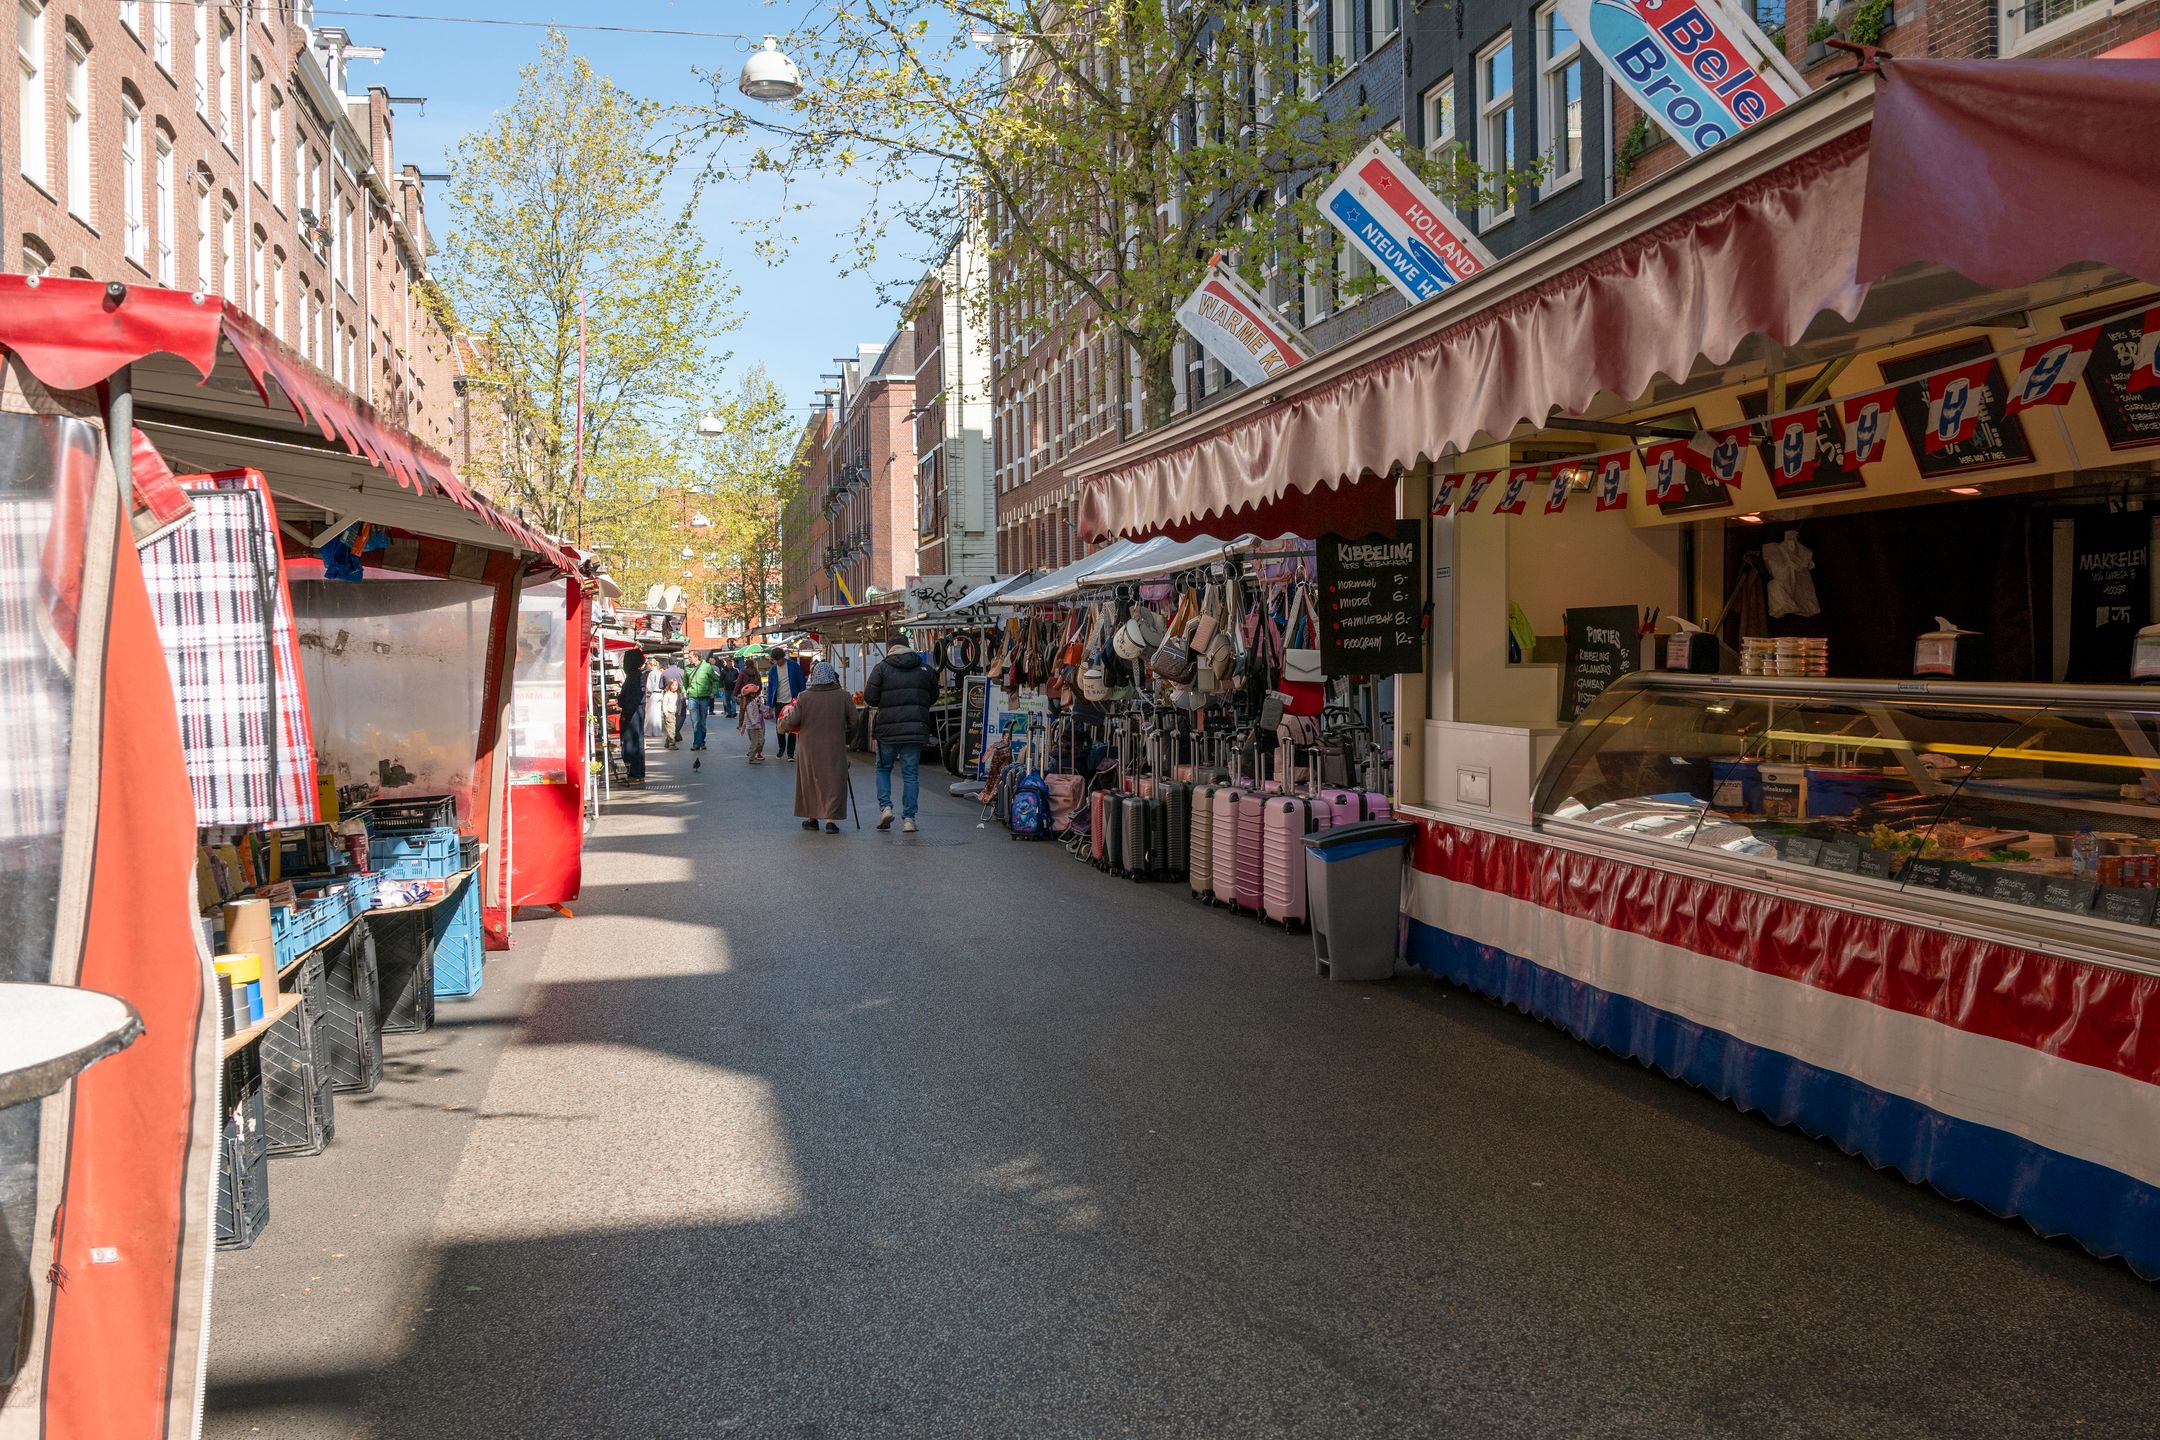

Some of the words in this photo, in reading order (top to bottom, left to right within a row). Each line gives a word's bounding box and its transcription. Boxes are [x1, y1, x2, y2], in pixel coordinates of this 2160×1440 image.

[1658, 6, 1765, 124] Bele
[1405, 204, 1479, 275] HOLLAND
[1361, 223, 1420, 282] NIEUWE
[1198, 294, 1268, 356] WARME
[1337, 542, 1413, 562] KIBBELING
[2080, 546, 2147, 571] MAKRELEN
[1342, 561, 1360, 570] VERS
[1337, 577, 1377, 590] NORMAAL
[1586, 625, 1621, 649] PORTIES
[1576, 678, 1605, 691] GAMBAS
